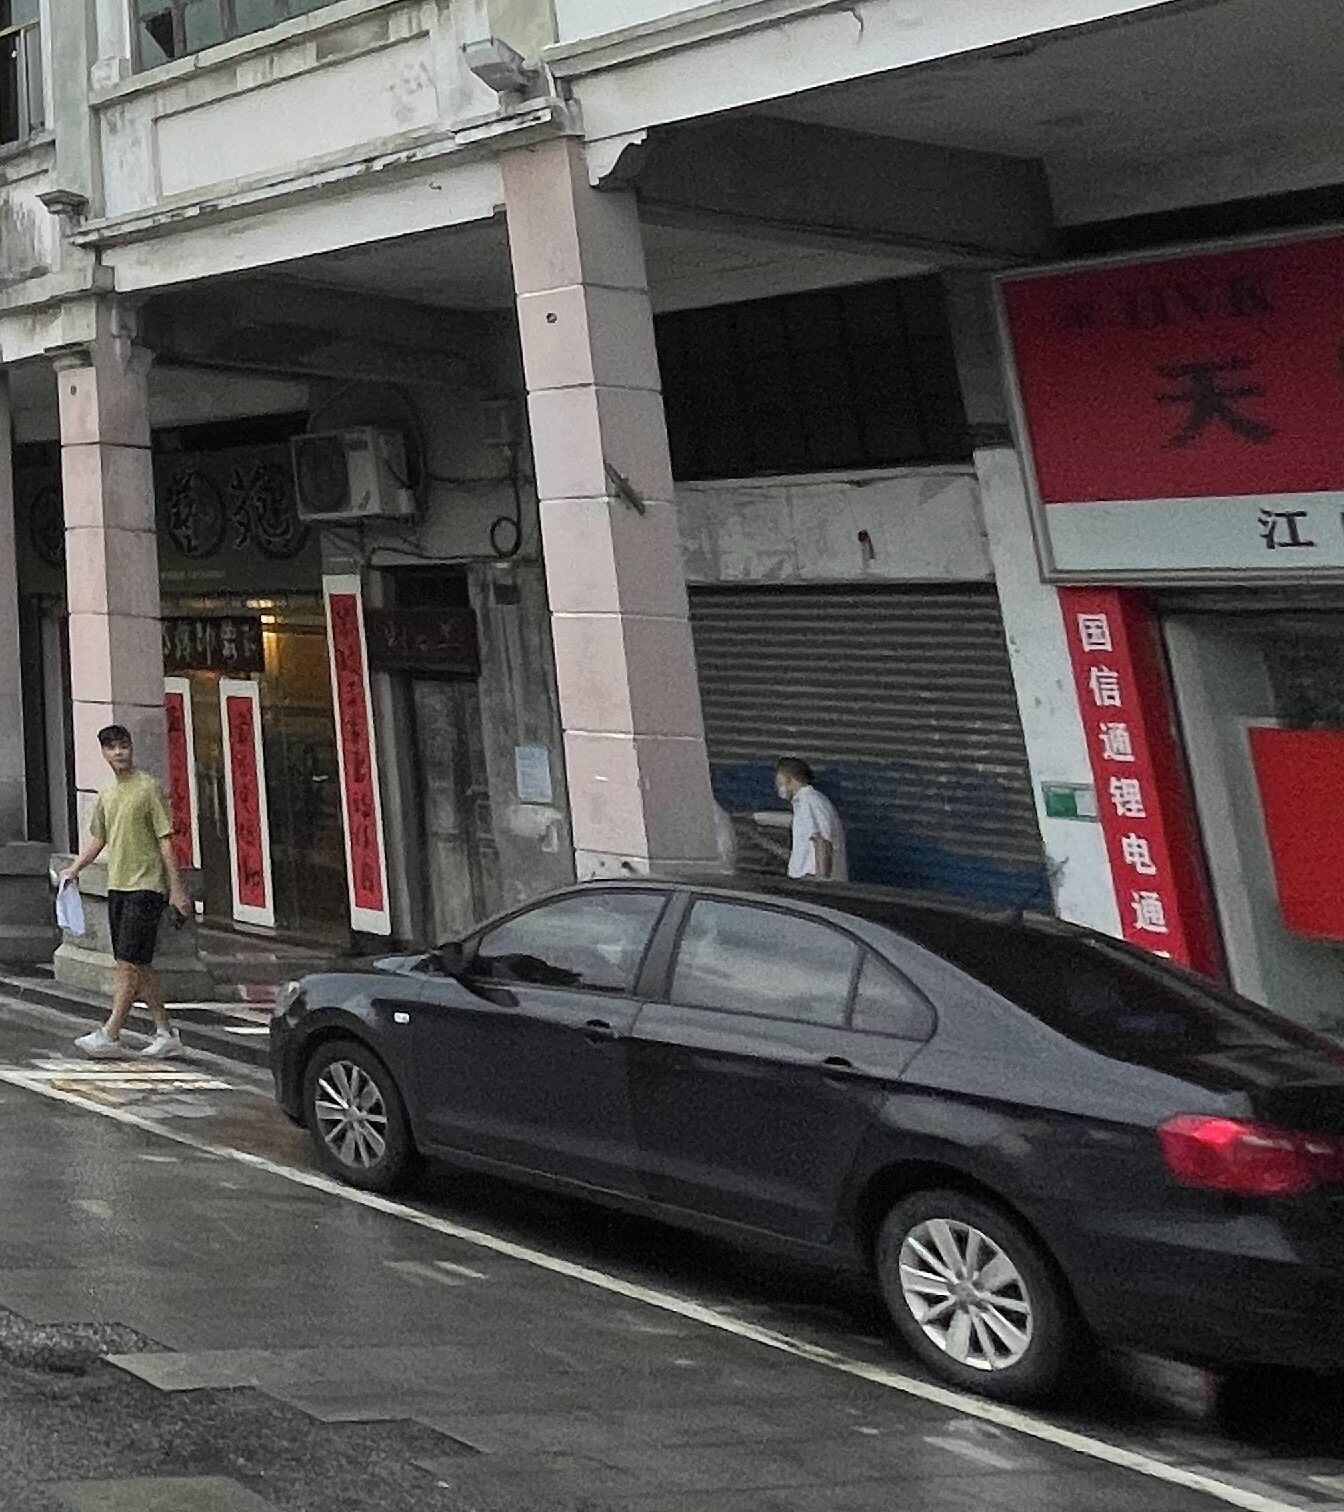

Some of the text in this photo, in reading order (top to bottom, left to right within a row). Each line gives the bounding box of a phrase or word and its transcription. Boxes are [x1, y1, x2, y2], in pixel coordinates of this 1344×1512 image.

[1156, 356, 1344, 451] 天
[1076, 613, 1172, 958] 国信通锂电通
